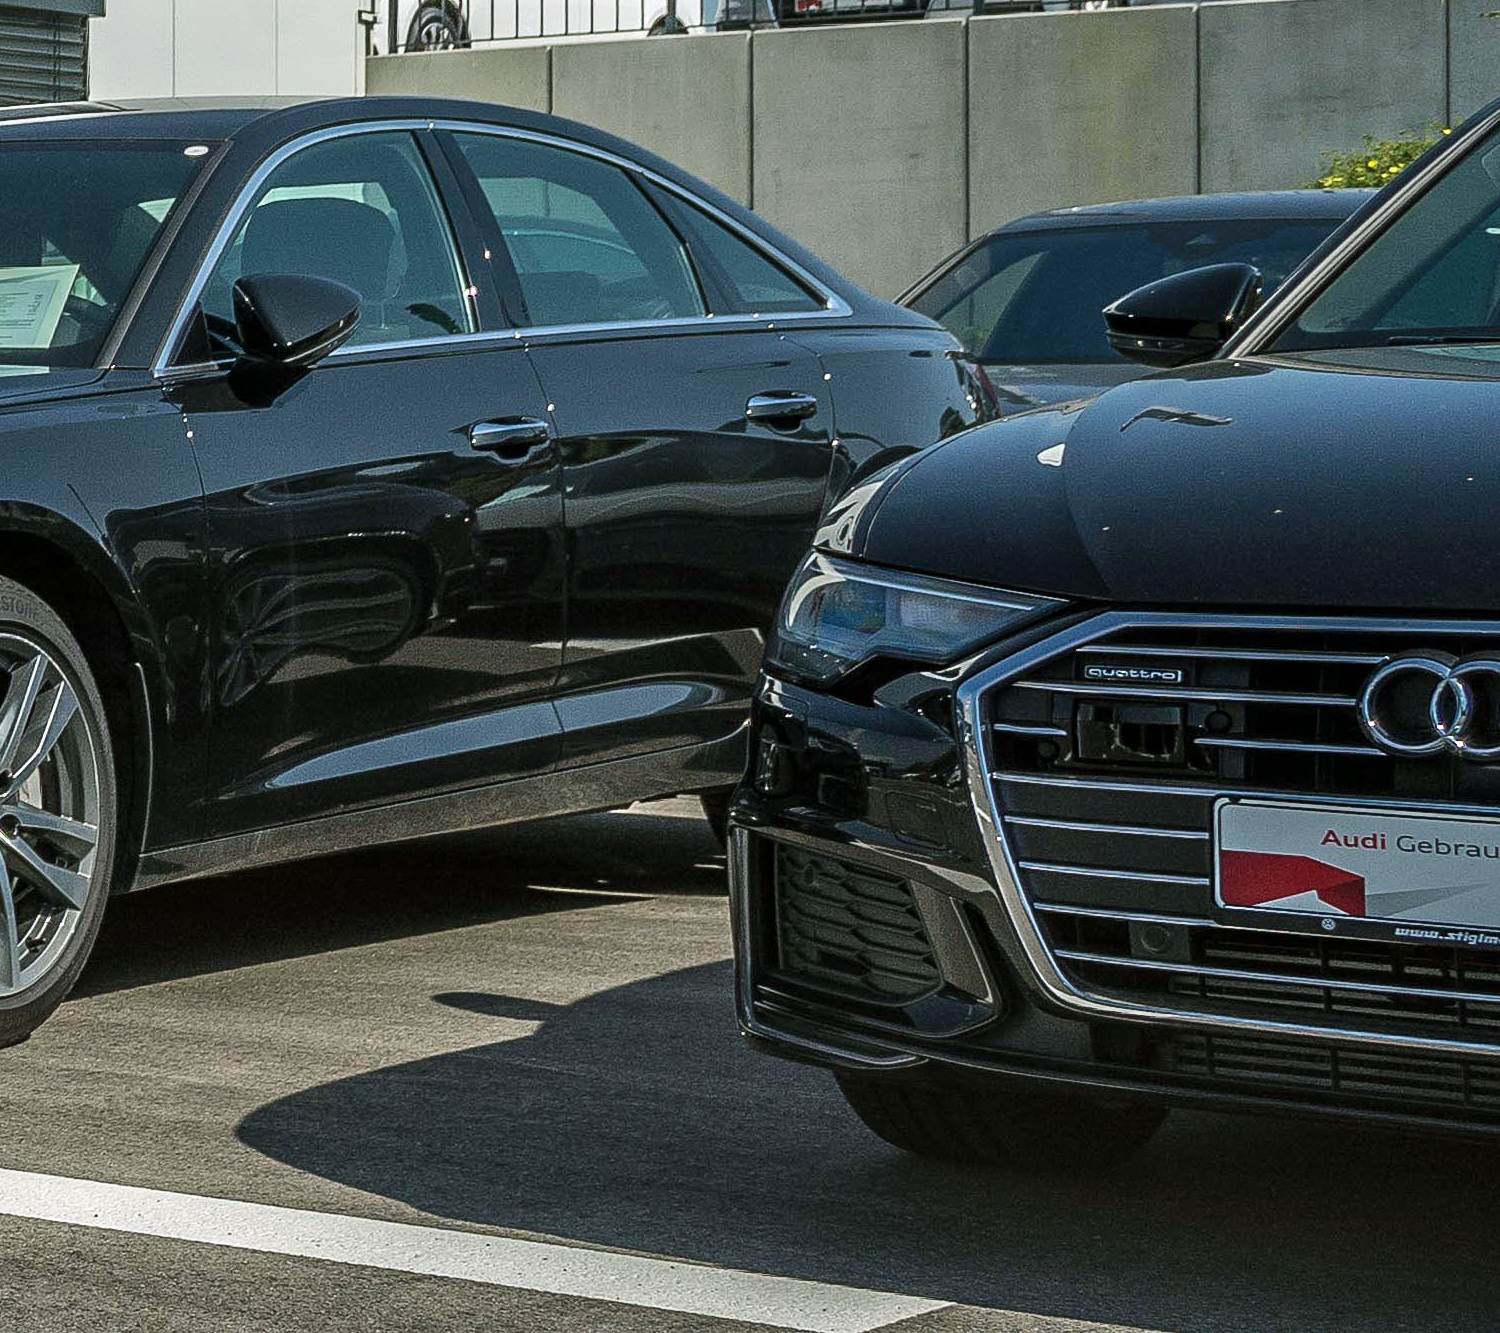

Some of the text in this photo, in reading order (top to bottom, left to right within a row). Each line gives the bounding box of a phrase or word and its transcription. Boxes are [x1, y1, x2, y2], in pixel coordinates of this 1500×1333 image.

[1088, 668, 1176, 680] quattro
[1320, 829, 1387, 850] Audi
[1394, 927, 1500, 945] www.stiglm
